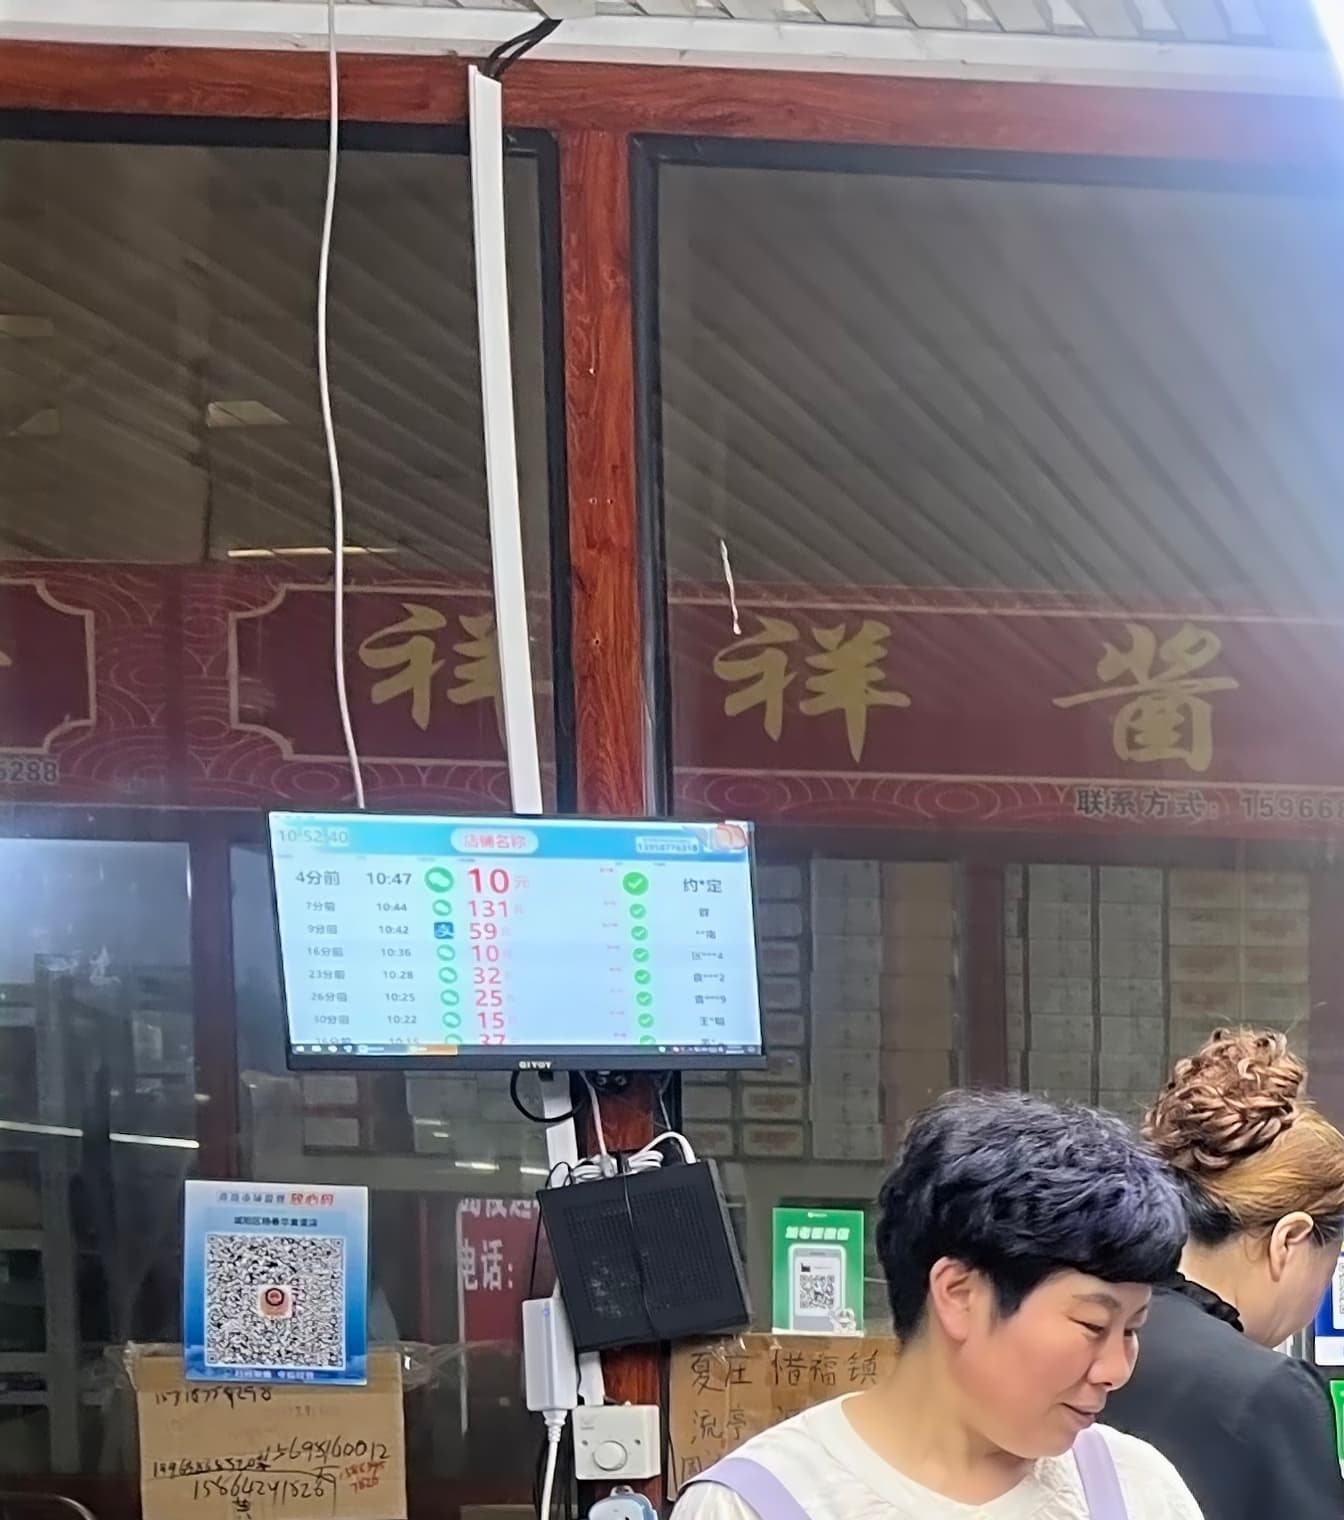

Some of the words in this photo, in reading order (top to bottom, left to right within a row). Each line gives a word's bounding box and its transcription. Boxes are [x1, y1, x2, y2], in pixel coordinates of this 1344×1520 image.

[296, 870, 340, 886] 4分前
[366, 872, 412, 886] 10:47
[468, 868, 509, 893] 10
[469, 900, 508, 917] 131
[469, 923, 497, 939] 59
[473, 945, 498, 961] 10
[473, 967, 502, 984] 32
[385, 993, 415, 1002] 10:25
[475, 990, 503, 1007] 25
[387, 1015, 417, 1024] 10:22
[478, 1012, 505, 1029] 15
